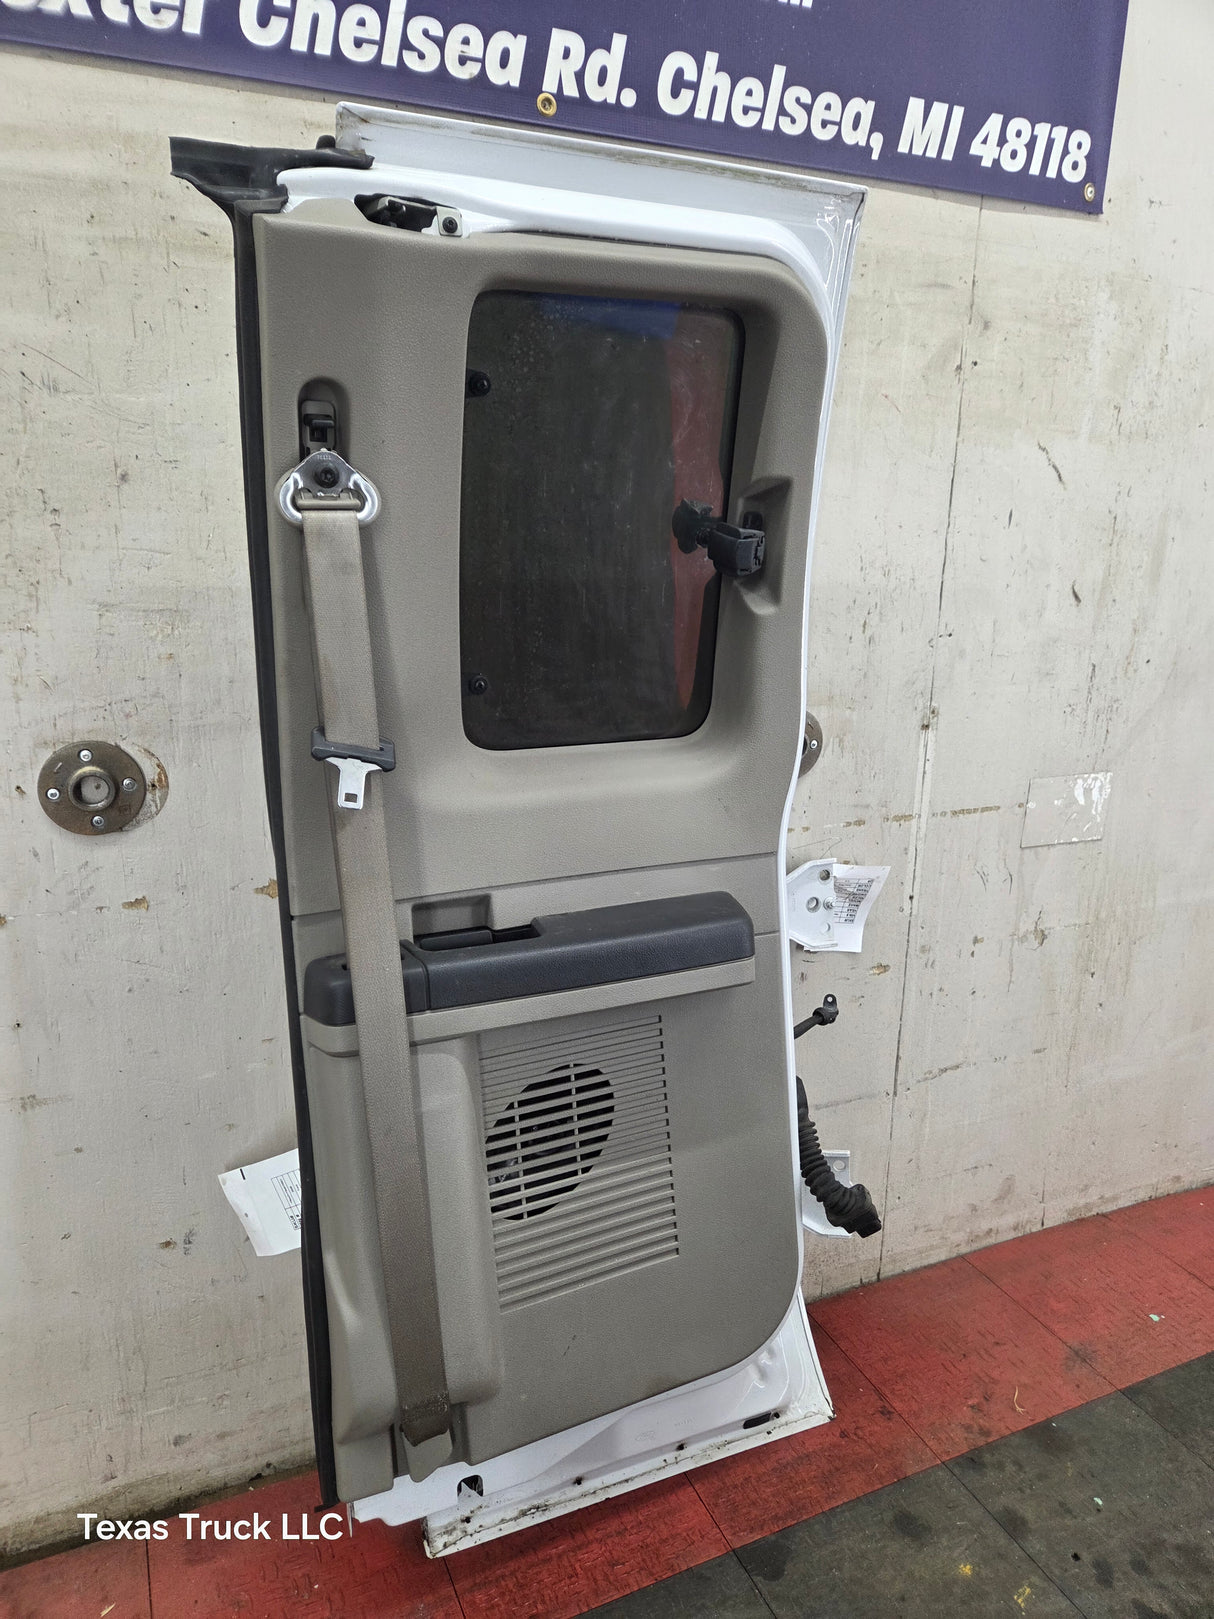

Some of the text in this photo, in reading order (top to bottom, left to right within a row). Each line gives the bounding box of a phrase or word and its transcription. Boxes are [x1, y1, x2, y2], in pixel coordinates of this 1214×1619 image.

[239, 0, 527, 87] Chelsea
[543, 28, 637, 107] Rd.
[657, 51, 883, 160] Chelsea,
[897, 97, 965, 161] MI
[970, 113, 1092, 184] 48118
